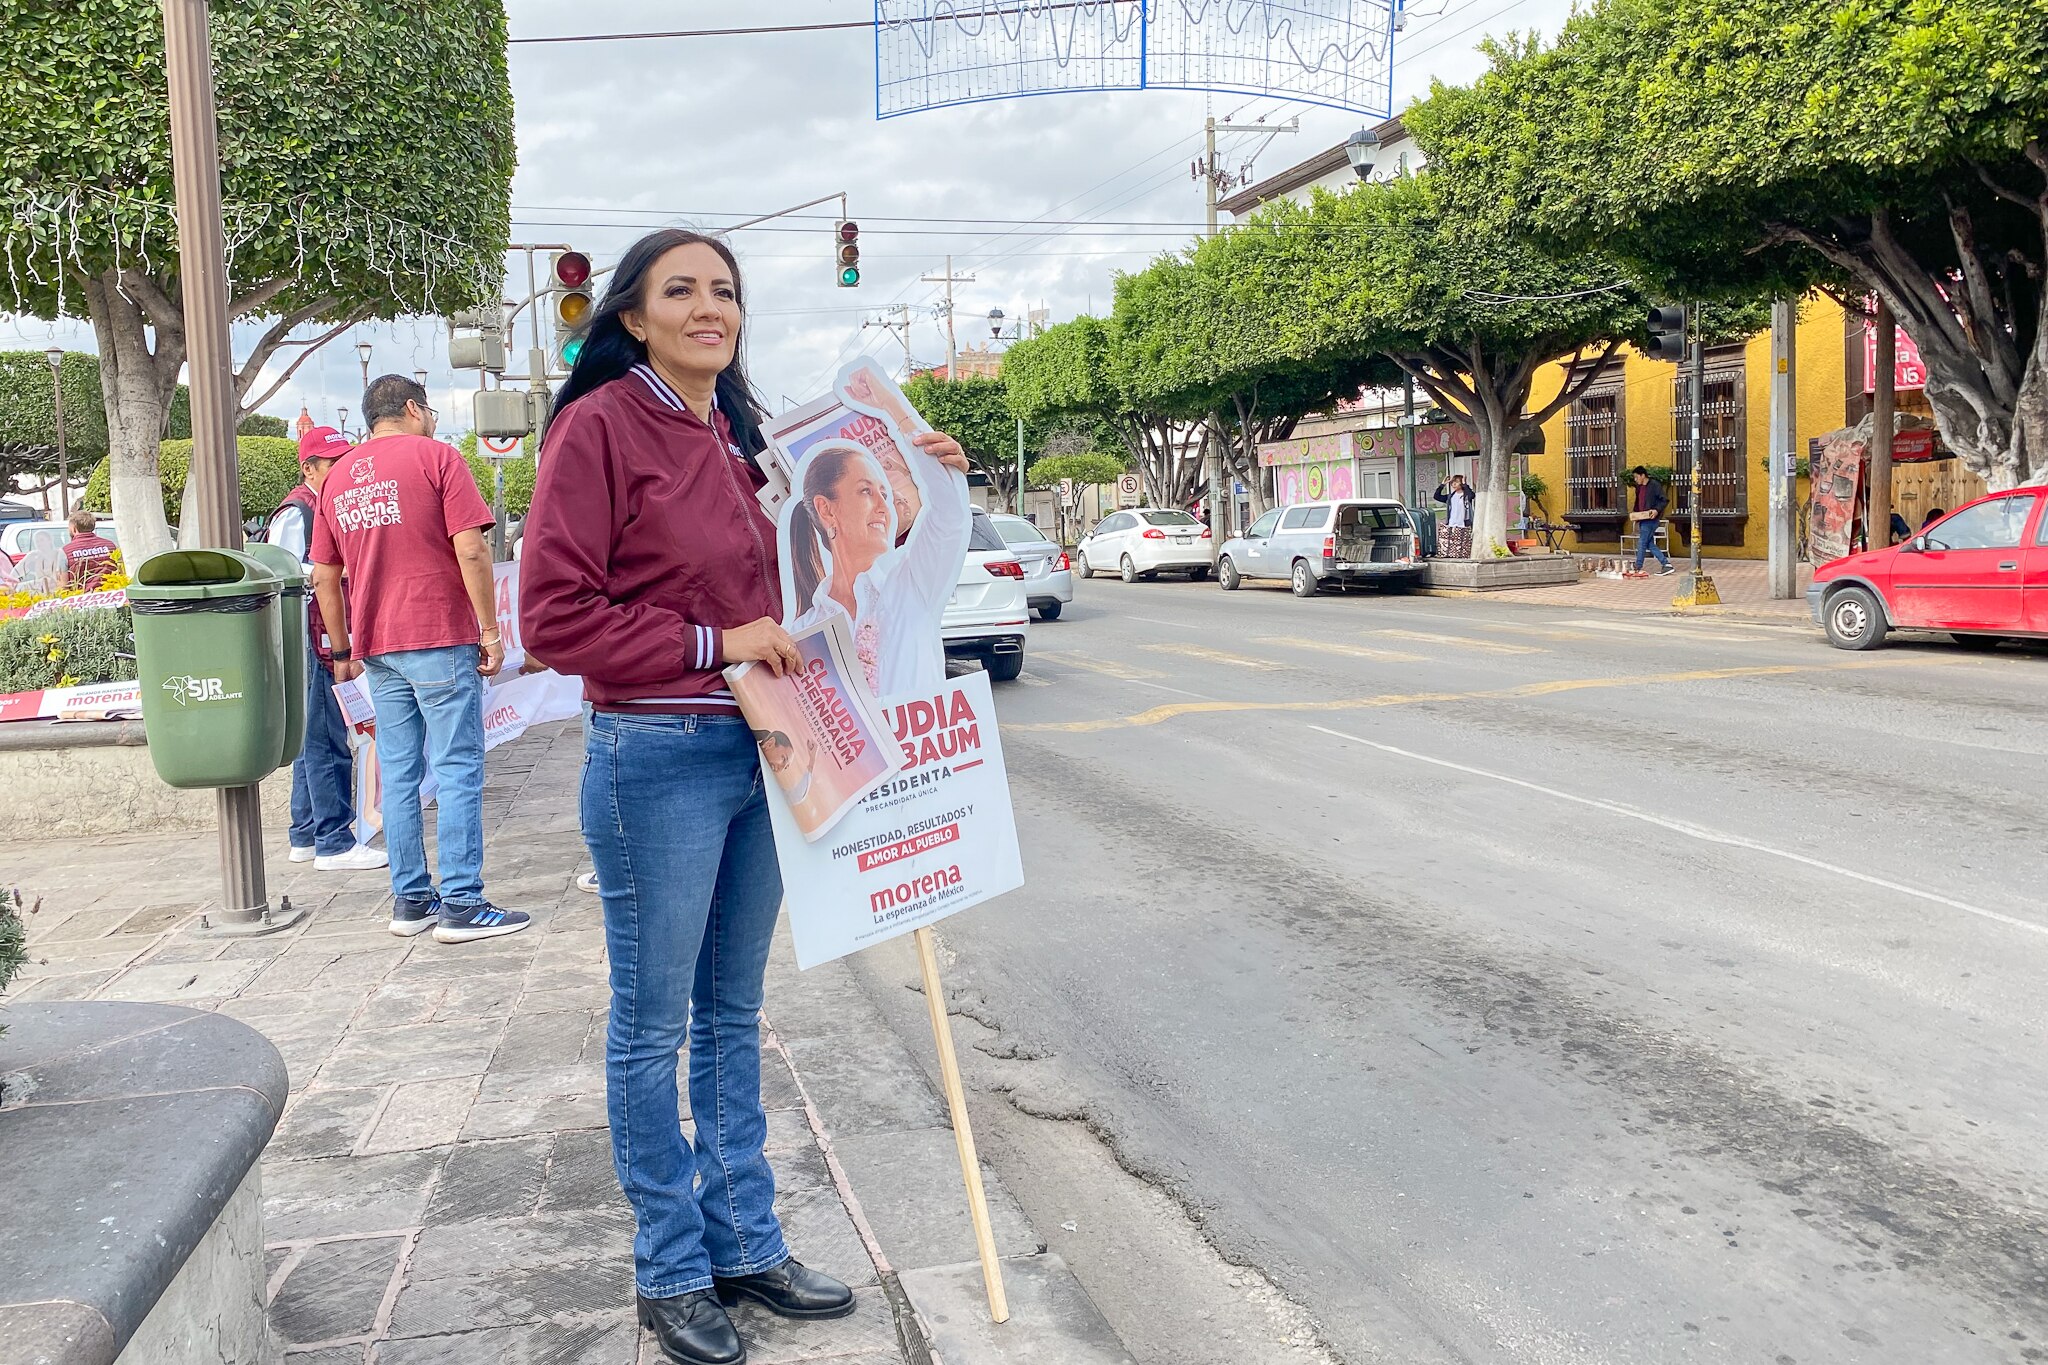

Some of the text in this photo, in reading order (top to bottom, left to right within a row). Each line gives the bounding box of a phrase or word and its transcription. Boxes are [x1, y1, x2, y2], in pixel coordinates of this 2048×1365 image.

[343, 498, 356, 506] UN
[357, 489, 398, 503] ORGULLO
[344, 480, 398, 499] MEXICANO
[337, 500, 401, 528] morena
[72, 545, 109, 557] morena
[66, 692, 133, 707] morena
[188, 678, 224, 702] SJR
[208, 692, 243, 701] ADELANTE
[808, 658, 866, 758] CLAUDIA
[799, 692, 832, 752] PRESIDENTA
[866, 786, 938, 813] PRECANDIDATA ÚNICA
[832, 804, 974, 860] HONESTIDAD, RESULTADOS Y
[866, 829, 953, 867] AMOR AL PUEBLO
[870, 864, 962, 913] morena
[874, 884, 965, 924] La esperanza de México
